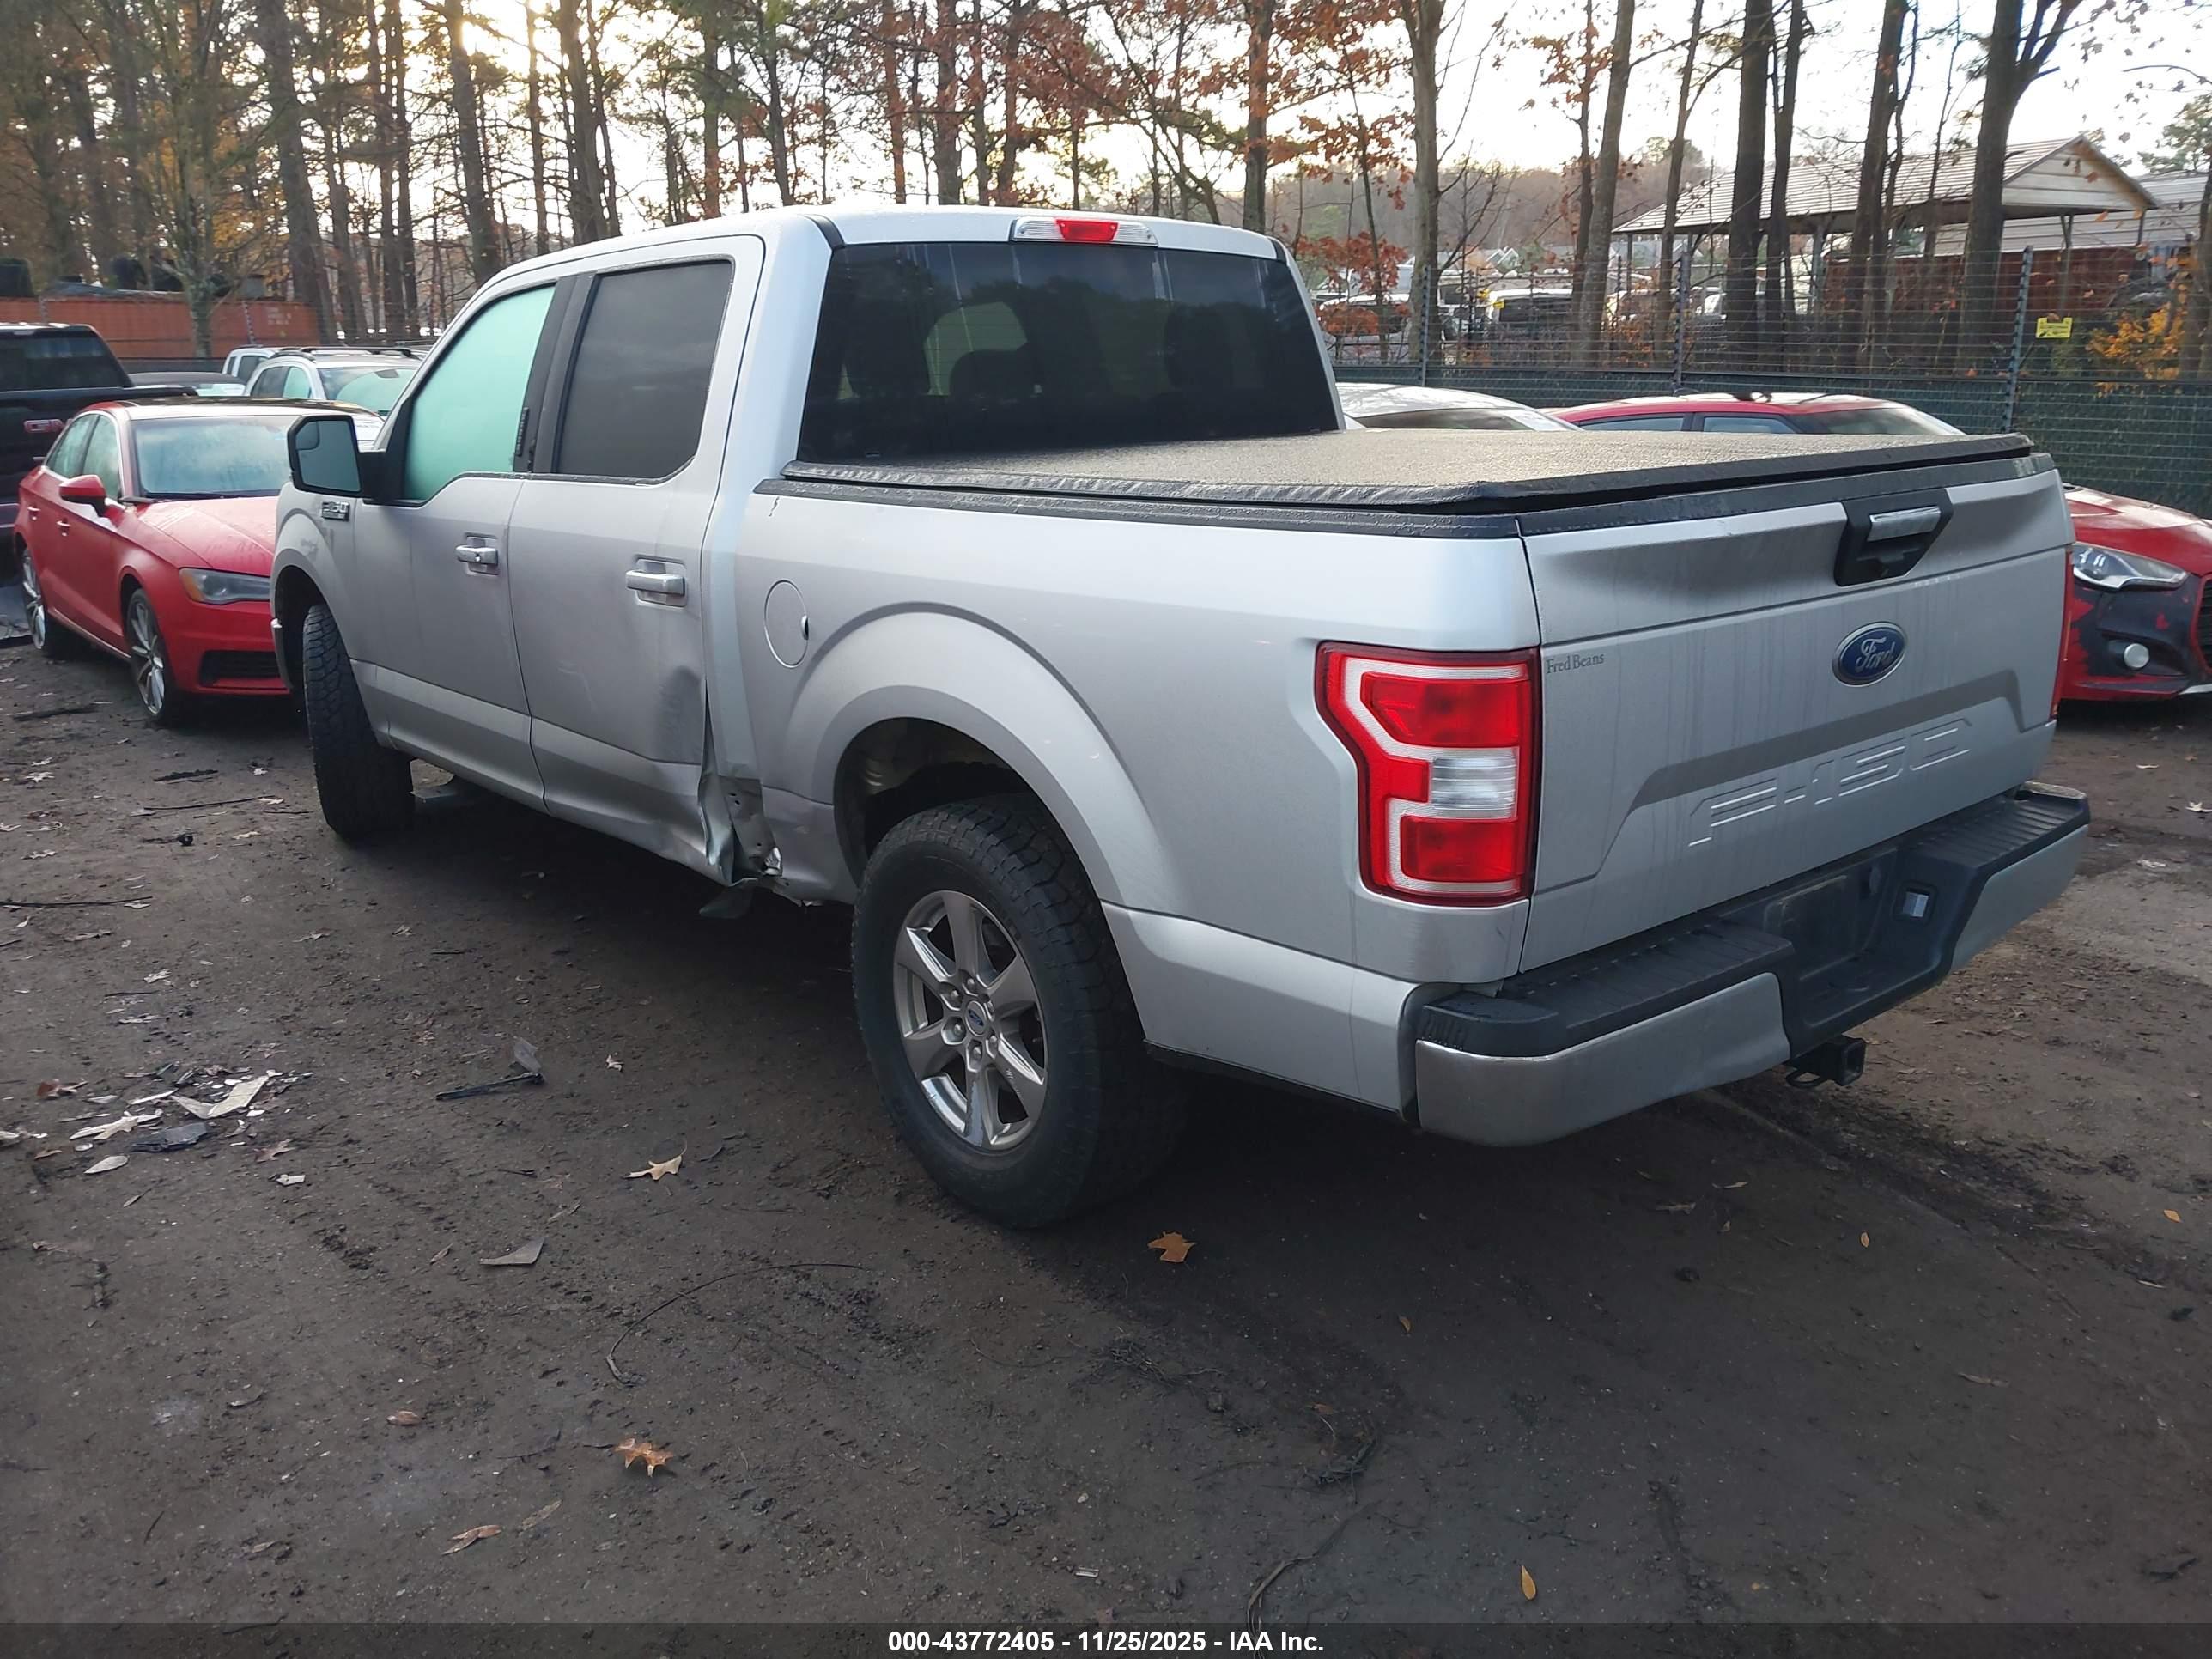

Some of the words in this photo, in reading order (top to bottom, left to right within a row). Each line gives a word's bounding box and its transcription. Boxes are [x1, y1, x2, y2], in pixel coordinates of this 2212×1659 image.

[24, 418, 74, 434] GM
[1546, 655, 1571, 674] Fred
[1572, 653, 1605, 670] Beans
[1855, 636, 1896, 673] Ford
